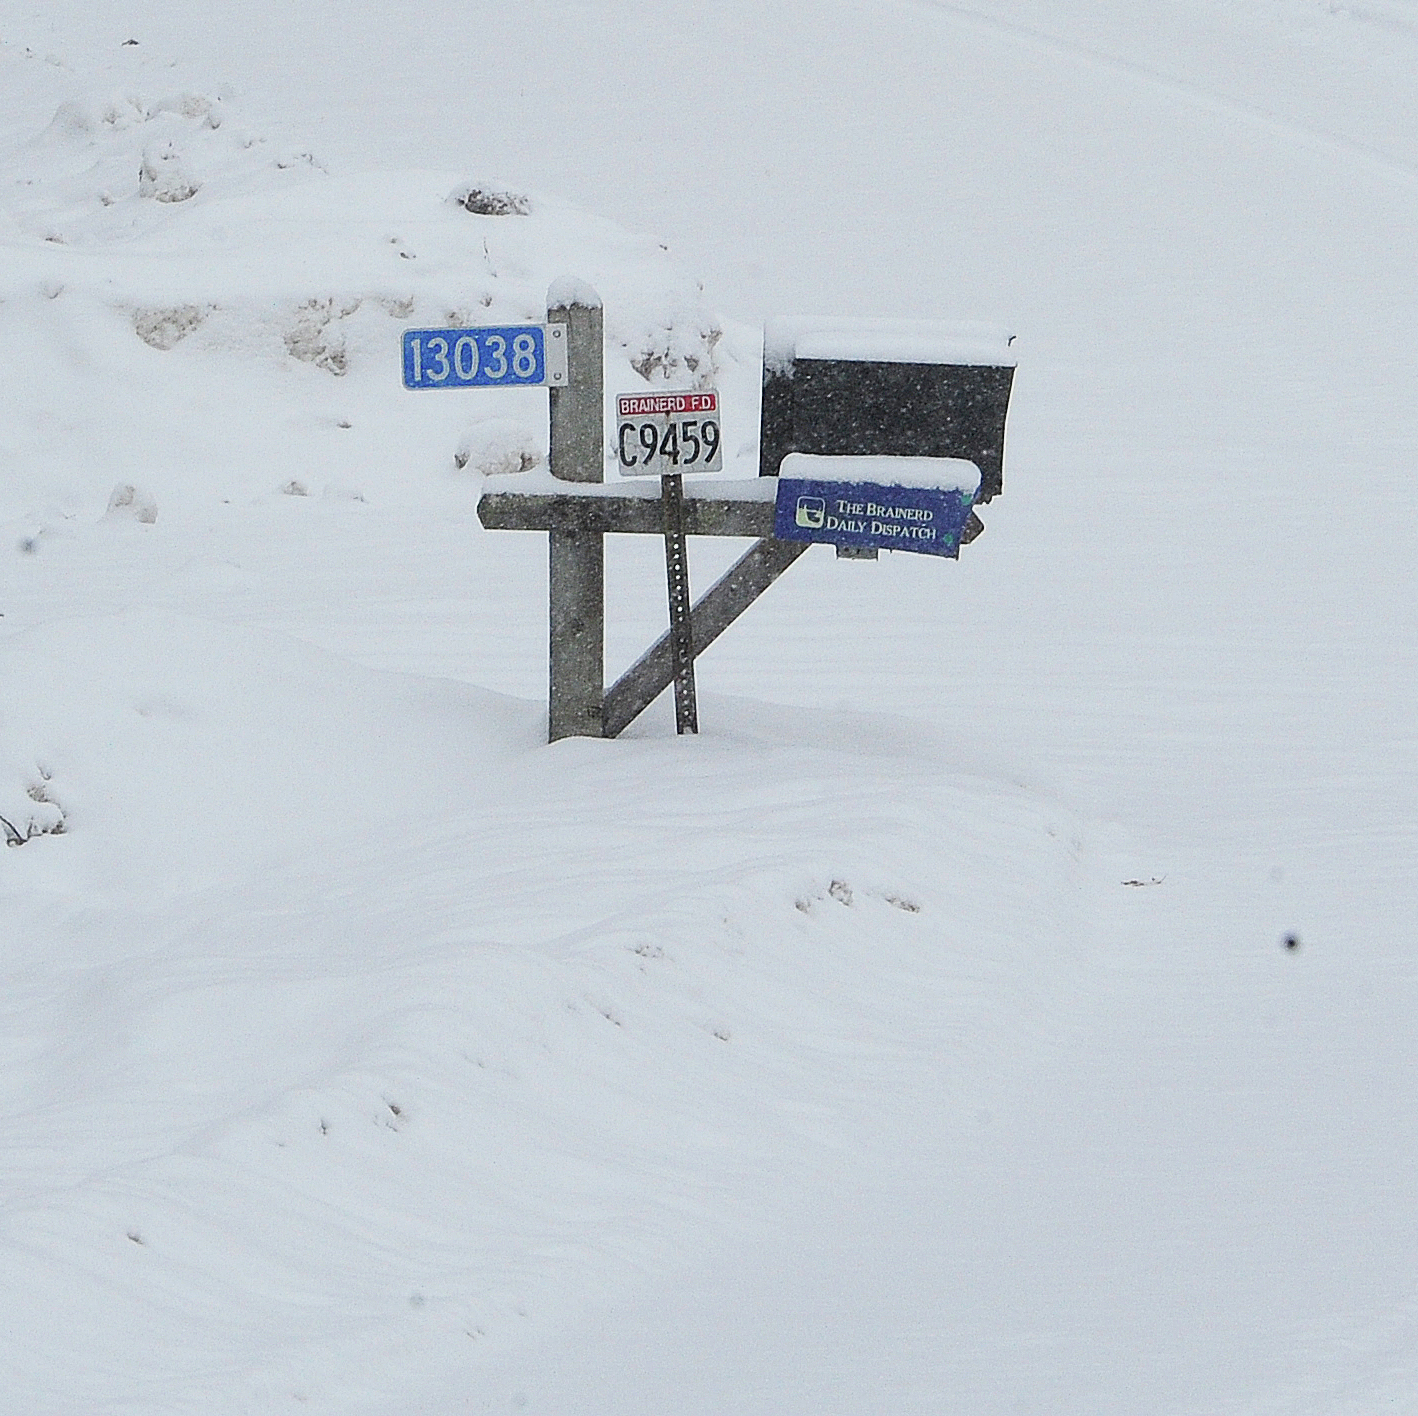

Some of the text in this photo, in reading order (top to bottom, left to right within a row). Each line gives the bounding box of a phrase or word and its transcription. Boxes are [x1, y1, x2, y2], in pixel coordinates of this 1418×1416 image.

[409, 332, 538, 383] 13038
[620, 395, 714, 414] BRAINERD F.D.
[619, 420, 720, 467] C9459
[836, 499, 933, 521] THE BRAINERD
[826, 516, 937, 540] DAILY DISPATCH
